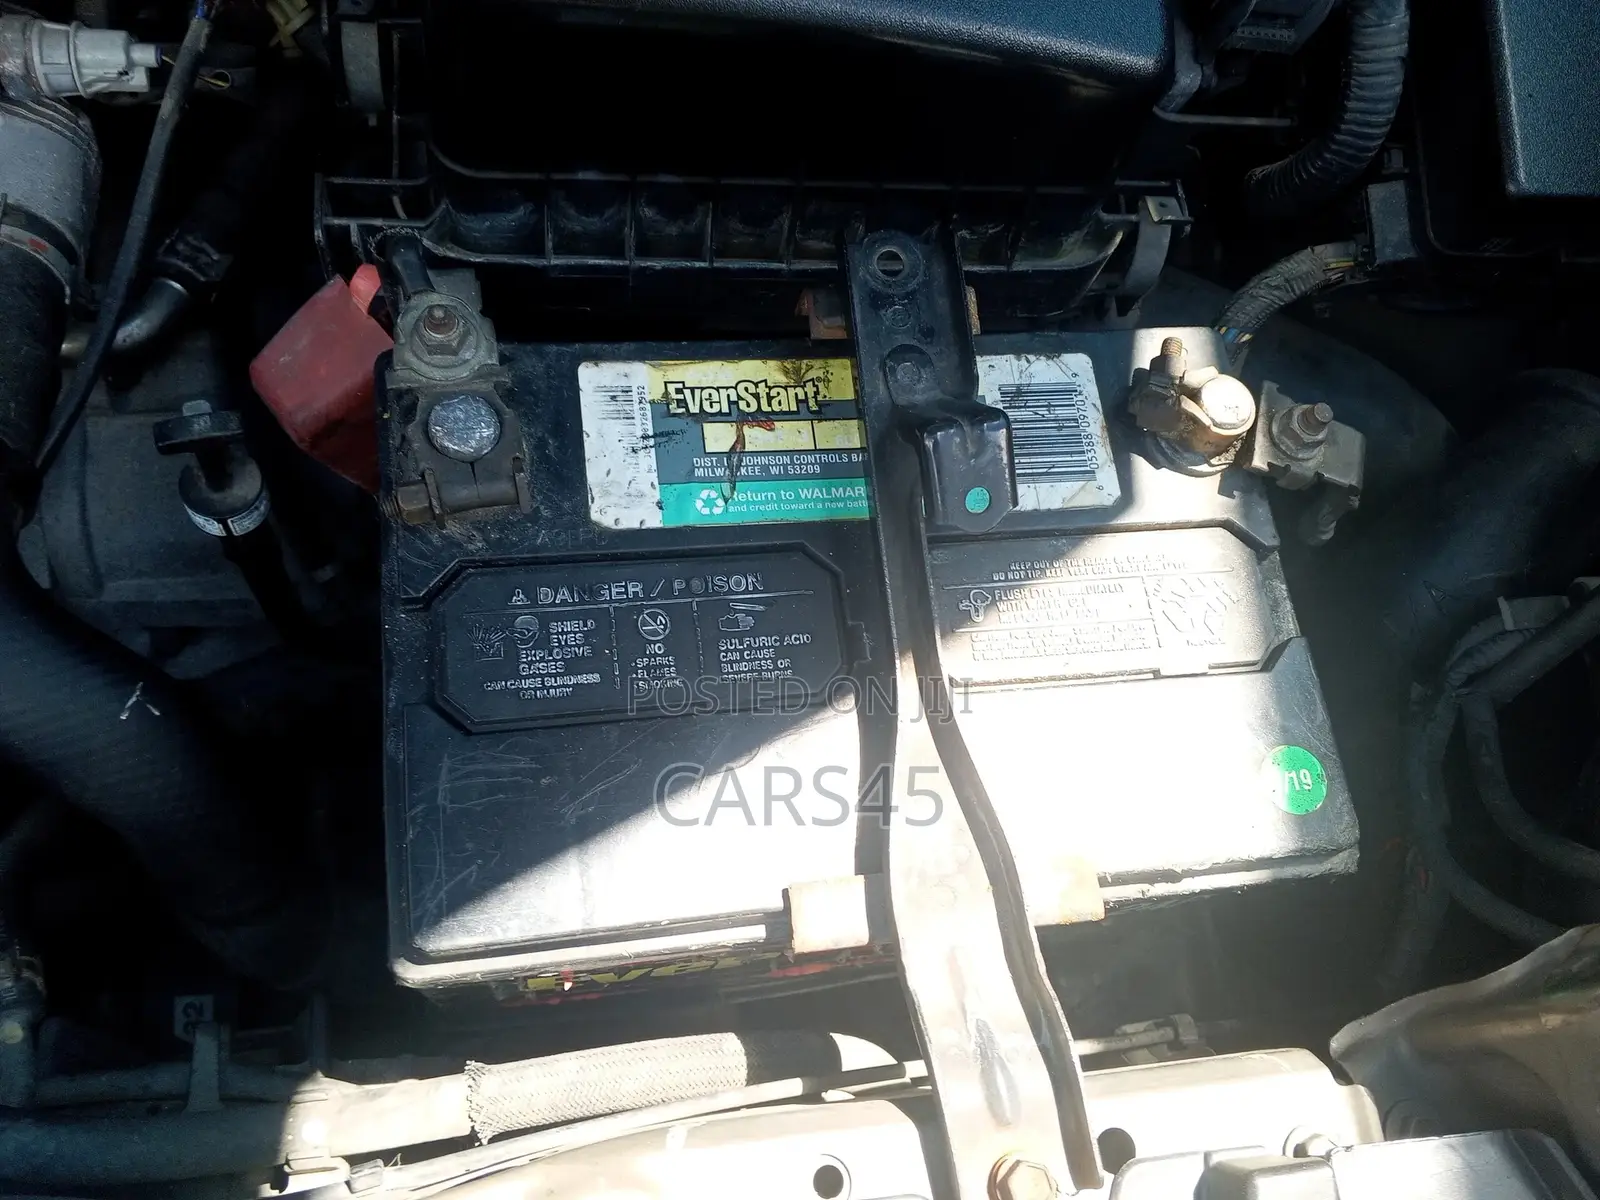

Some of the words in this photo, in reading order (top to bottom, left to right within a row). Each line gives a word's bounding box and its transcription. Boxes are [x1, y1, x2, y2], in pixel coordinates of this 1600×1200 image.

[693, 457, 720, 467] DIST.
[741, 454, 792, 466] JOHNSON
[794, 453, 849, 464] CONTROLS
[769, 465, 784, 475] WI
[787, 464, 821, 475] 53209
[780, 488, 795, 499] to
[798, 485, 866, 499] WALMAR
[728, 503, 747, 513] and
[749, 502, 778, 512] credit
[780, 501, 815, 511] toward
[825, 501, 845, 509] new
[993, 571, 1006, 581] DO
[536, 580, 644, 605] DANGER
[671, 573, 764, 596] POISON
[994, 588, 1028, 601] FLUSH
[548, 619, 596, 634] SHIELD
[549, 633, 585, 647] EYES
[718, 635, 781, 651] SULFURIC
[783, 633, 812, 646] ACID
[519, 646, 593, 662] EXPLOSIVE
[645, 643, 665, 655] NO
[720, 651, 740, 662] CAN
[743, 648, 776, 660] CAUSE
[518, 661, 566, 676] GASES
[636, 656, 676, 668] SPARKS
[721, 659, 774, 673] BLINDNESS
[777, 658, 792, 668] OR
[507, 677, 542, 689] CAUSE
[544, 672, 601, 687] BLINDNESS
